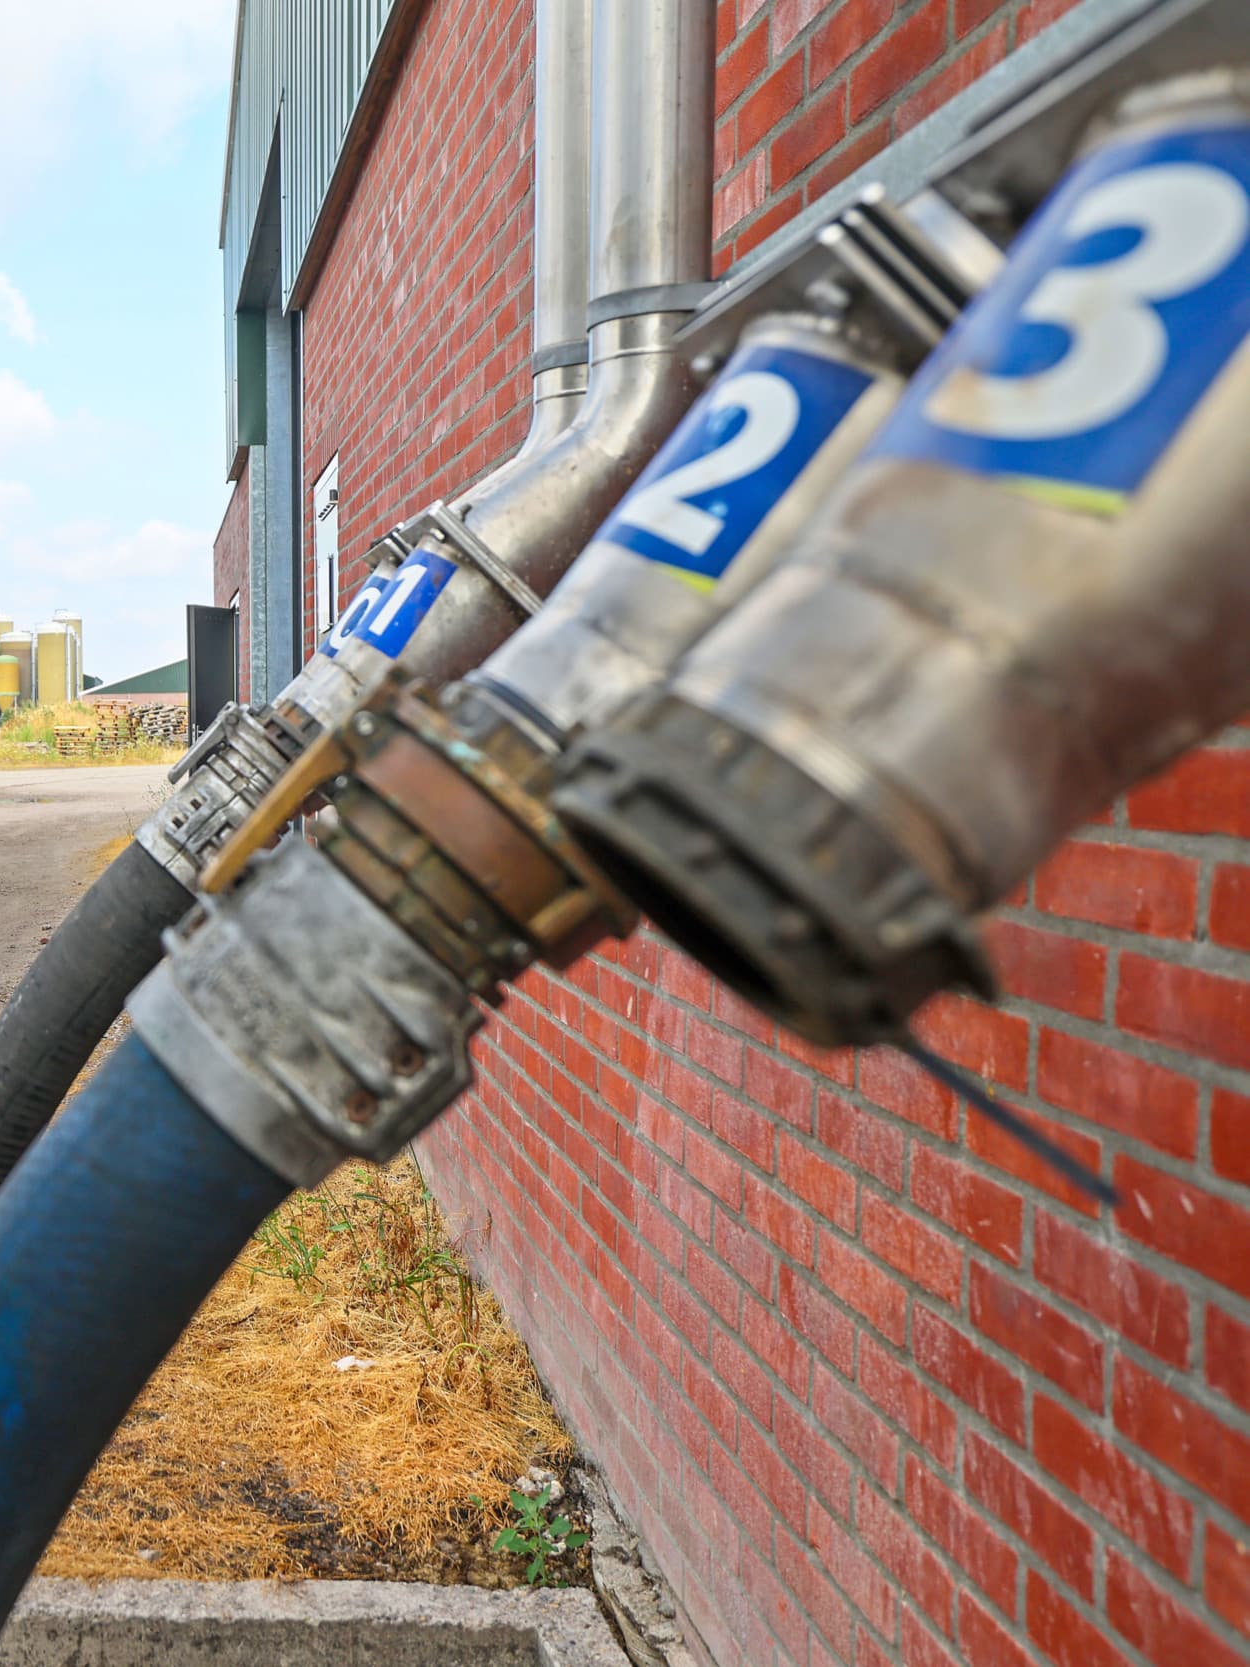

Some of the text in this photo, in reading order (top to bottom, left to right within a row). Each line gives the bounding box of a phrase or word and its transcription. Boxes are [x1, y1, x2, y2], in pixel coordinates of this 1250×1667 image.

[921, 162, 1249, 440] 3
[619, 371, 801, 557] 2
[368, 564, 428, 636] 1
